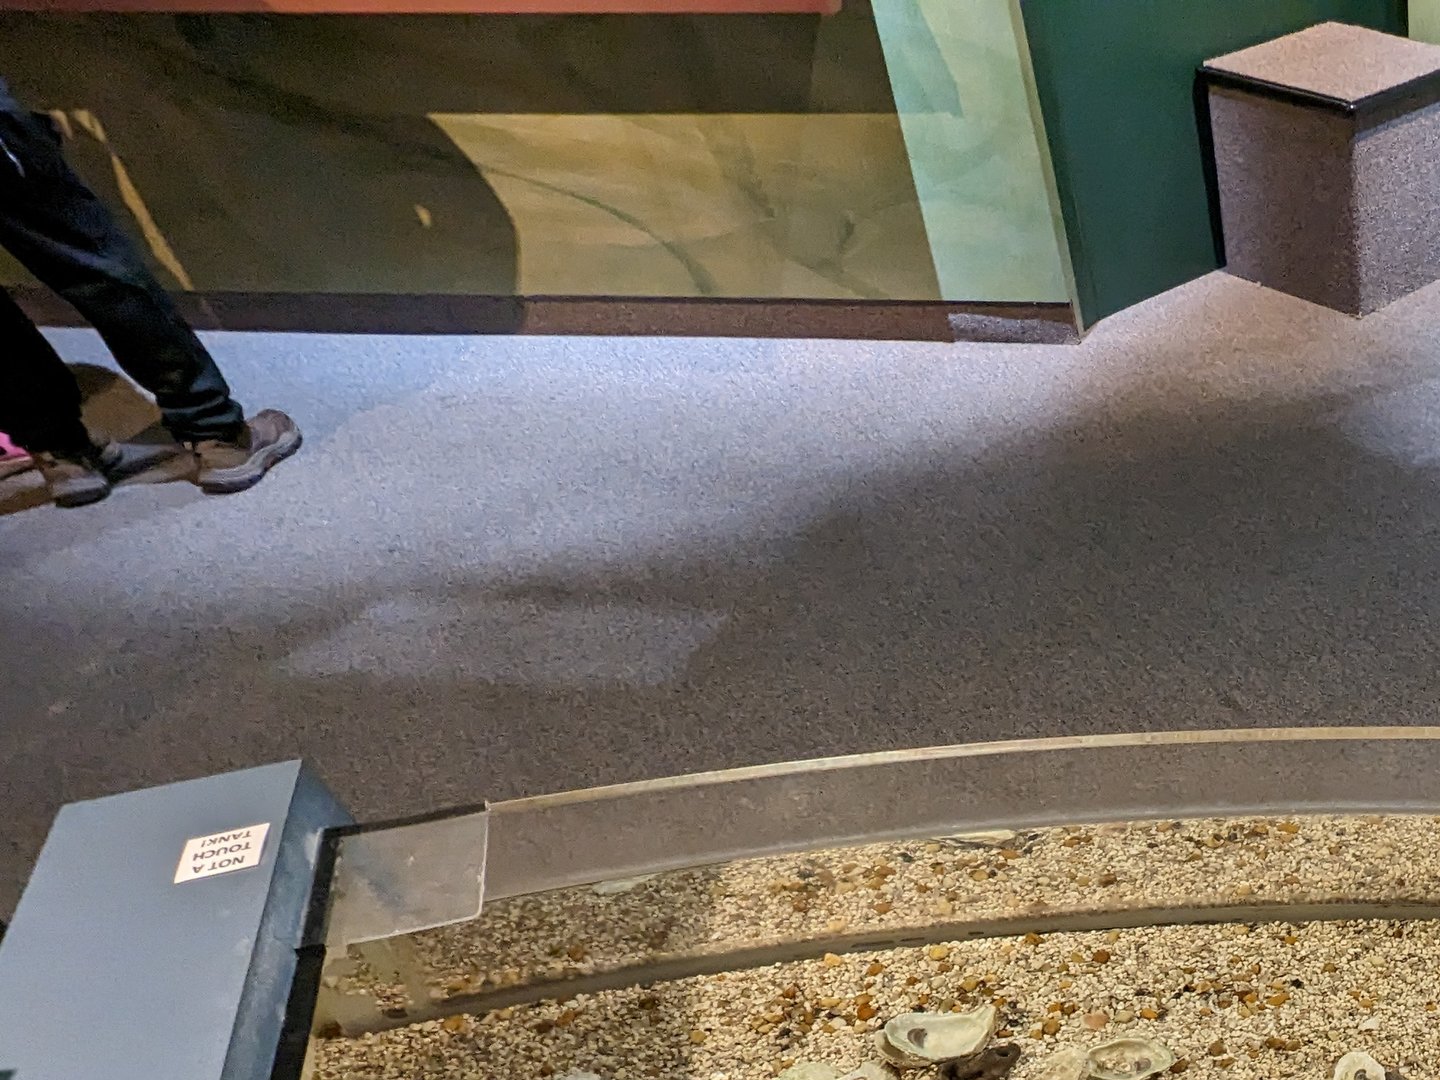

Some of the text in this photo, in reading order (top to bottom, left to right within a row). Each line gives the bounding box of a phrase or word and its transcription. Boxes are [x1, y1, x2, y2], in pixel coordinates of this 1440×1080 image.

[201, 829, 252, 848] TANK!
[193, 841, 252, 861] TOUCH
[192, 855, 246, 874] NOT A
